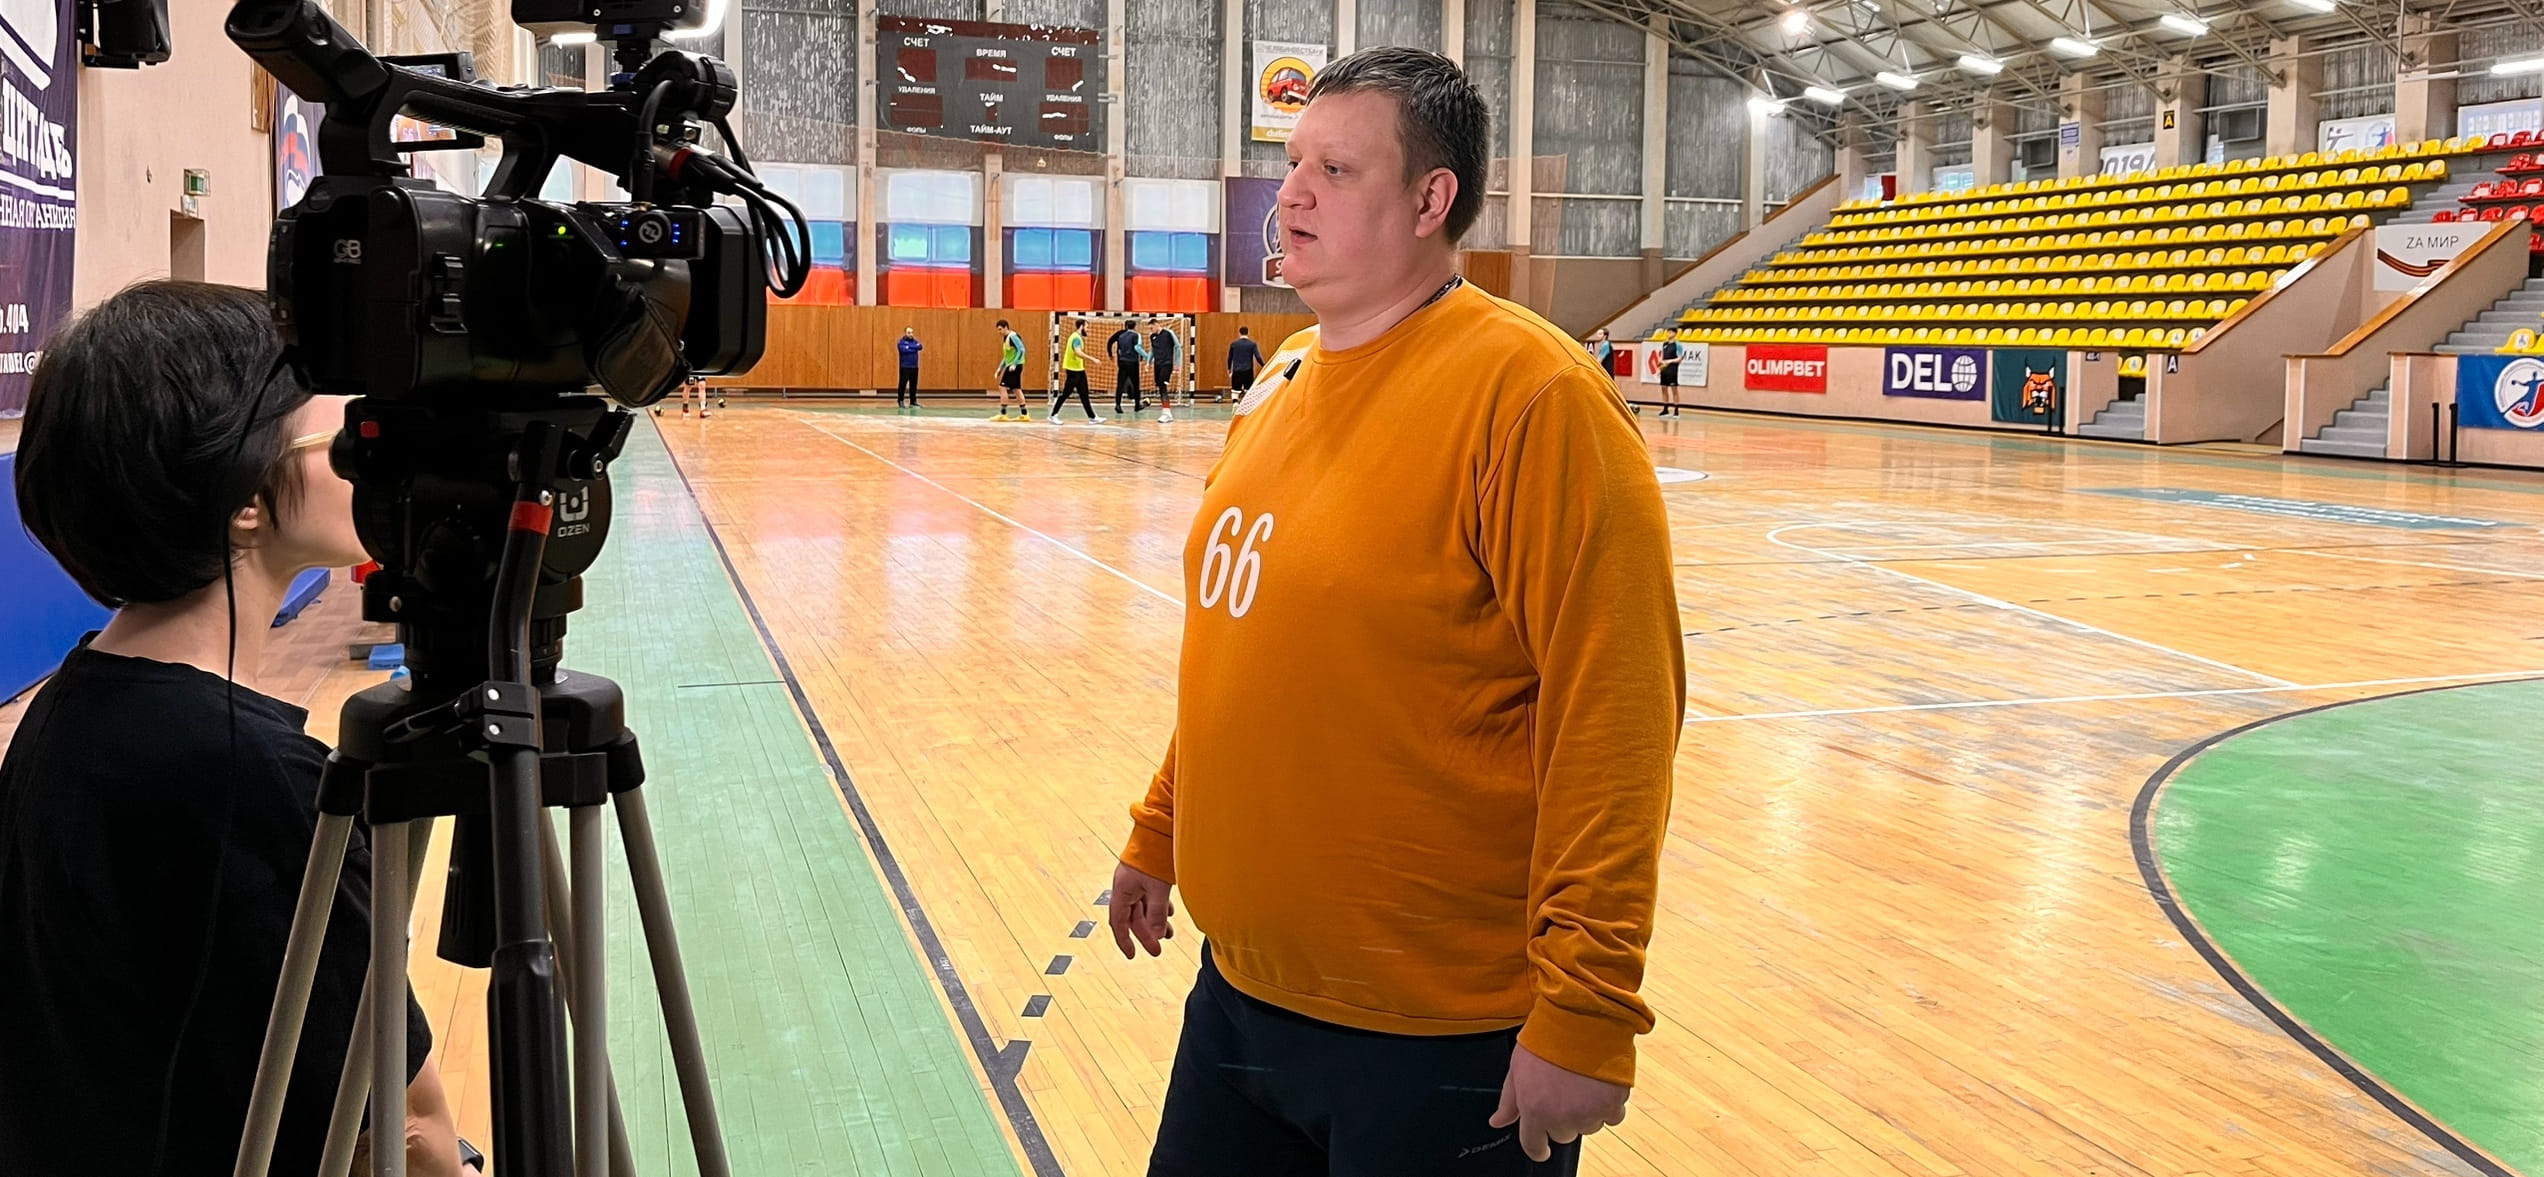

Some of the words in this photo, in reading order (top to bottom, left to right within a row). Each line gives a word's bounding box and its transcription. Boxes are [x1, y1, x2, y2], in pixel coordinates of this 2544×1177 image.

[904, 37, 930, 48] СЧЕТ
[976, 48, 1007, 58] ВРЕМЯ
[1051, 46, 1077, 57] СЧЕТ
[898, 86, 936, 95] УДАЛЕНИЯ
[980, 92, 1004, 102] ТАЙМ
[1046, 94, 1082, 103] УДАЛЕНИЯ
[970, 123, 1012, 135] ТАЙМ-АУТ
[2406, 236, 2424, 249] ZA
[2427, 235, 2460, 249] МИР
[1747, 359, 1826, 378] OLIMPBET
[557, 523, 591, 538] OZEN
[1199, 506, 1275, 619] 66
